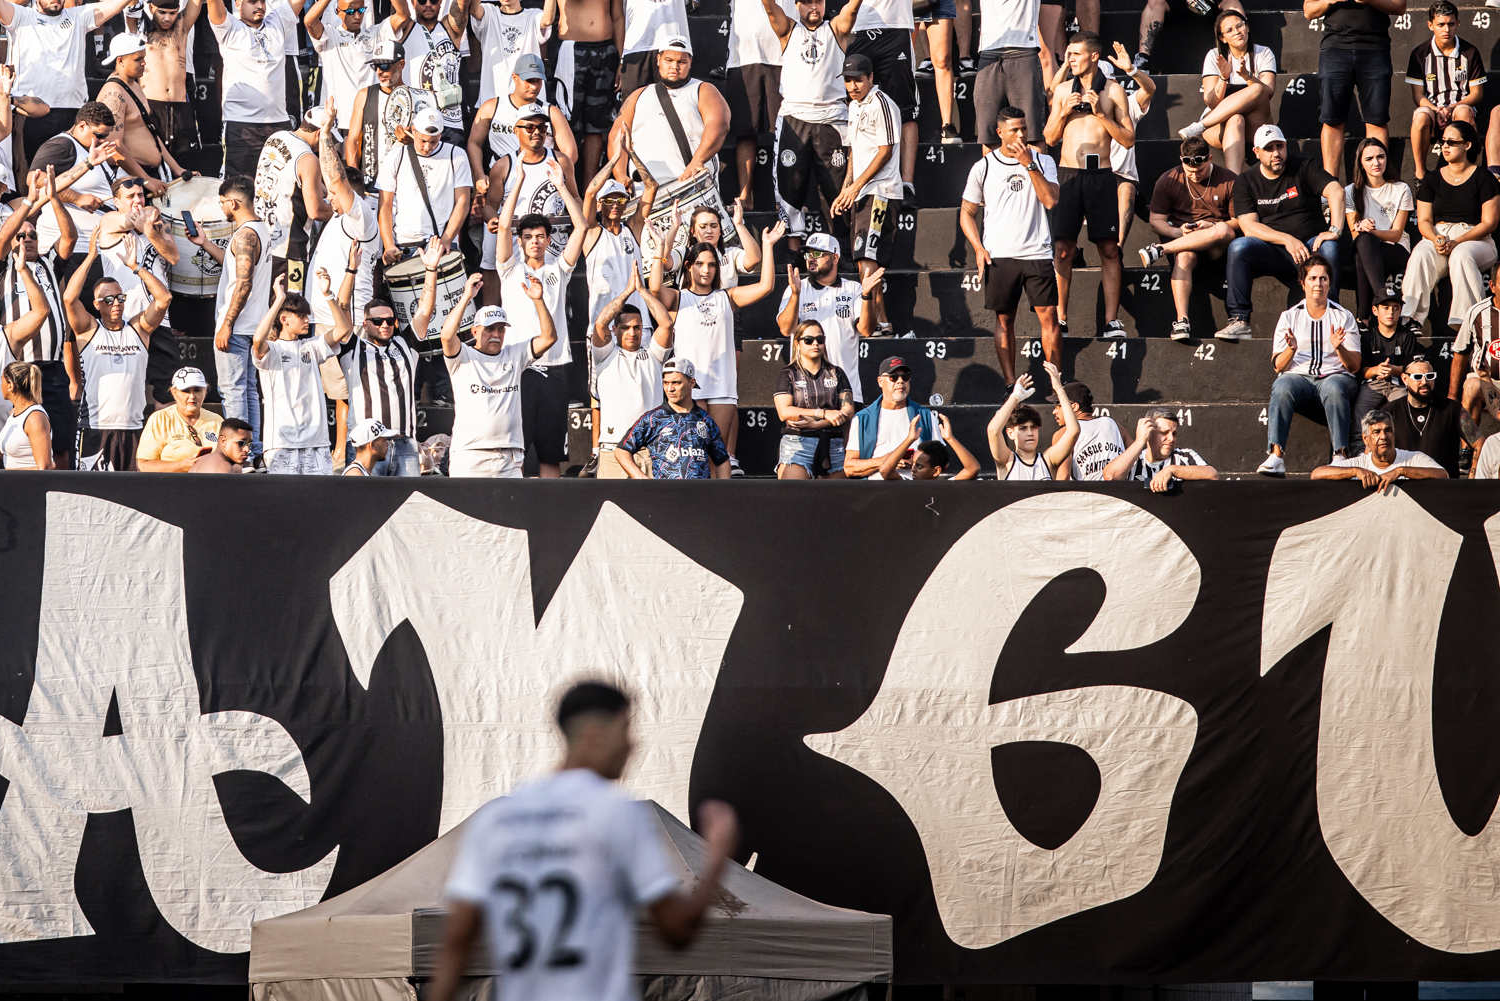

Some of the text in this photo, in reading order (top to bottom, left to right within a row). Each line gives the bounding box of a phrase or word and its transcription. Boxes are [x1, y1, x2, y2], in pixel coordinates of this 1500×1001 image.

[1394, 13, 1411, 30] 48
[1472, 11, 1491, 29] 49
[1285, 77, 1305, 95] 46
[926, 146, 945, 164] 41
[1140, 272, 1161, 291] 42
[177, 341, 197, 360] 30
[761, 343, 783, 361] 37
[924, 341, 945, 359] 39
[1020, 341, 1042, 359] 40
[1106, 341, 1128, 359] 41
[1194, 343, 1215, 361] 42
[569, 408, 591, 426] 34
[746, 409, 767, 428] 36
[1104, 441, 1124, 456] JOVE
[488, 872, 585, 970] 32
